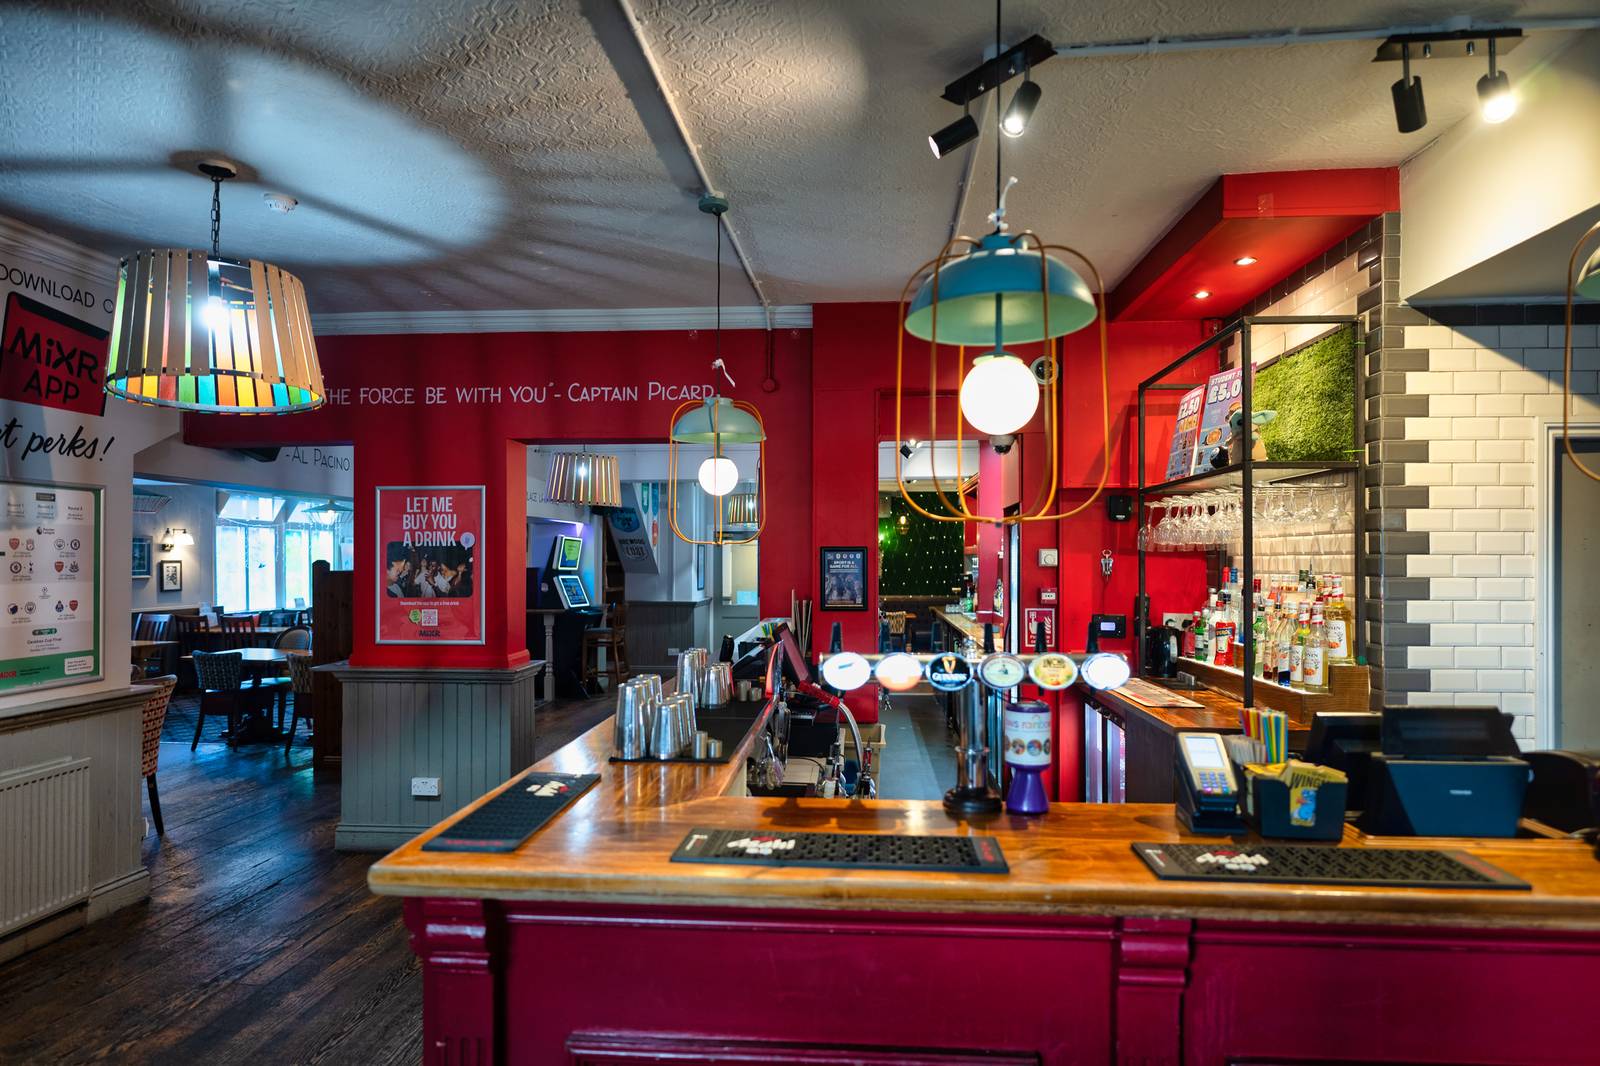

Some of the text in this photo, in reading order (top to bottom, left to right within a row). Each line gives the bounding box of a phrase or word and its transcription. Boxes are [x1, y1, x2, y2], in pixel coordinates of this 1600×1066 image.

[0, 264, 95, 308] DOWNLOAD
[23, 369, 80, 404] APP
[359, 387, 415, 405] FORCE
[425, 386, 447, 405] BE
[455, 386, 502, 404] WITH
[1207, 380, 1242, 405] £5.0
[21, 425, 115, 461] perks!
[406, 496, 453, 513] LET ME
[402, 514, 457, 530] BUY YOU
[402, 531, 457, 547] A DRINK
